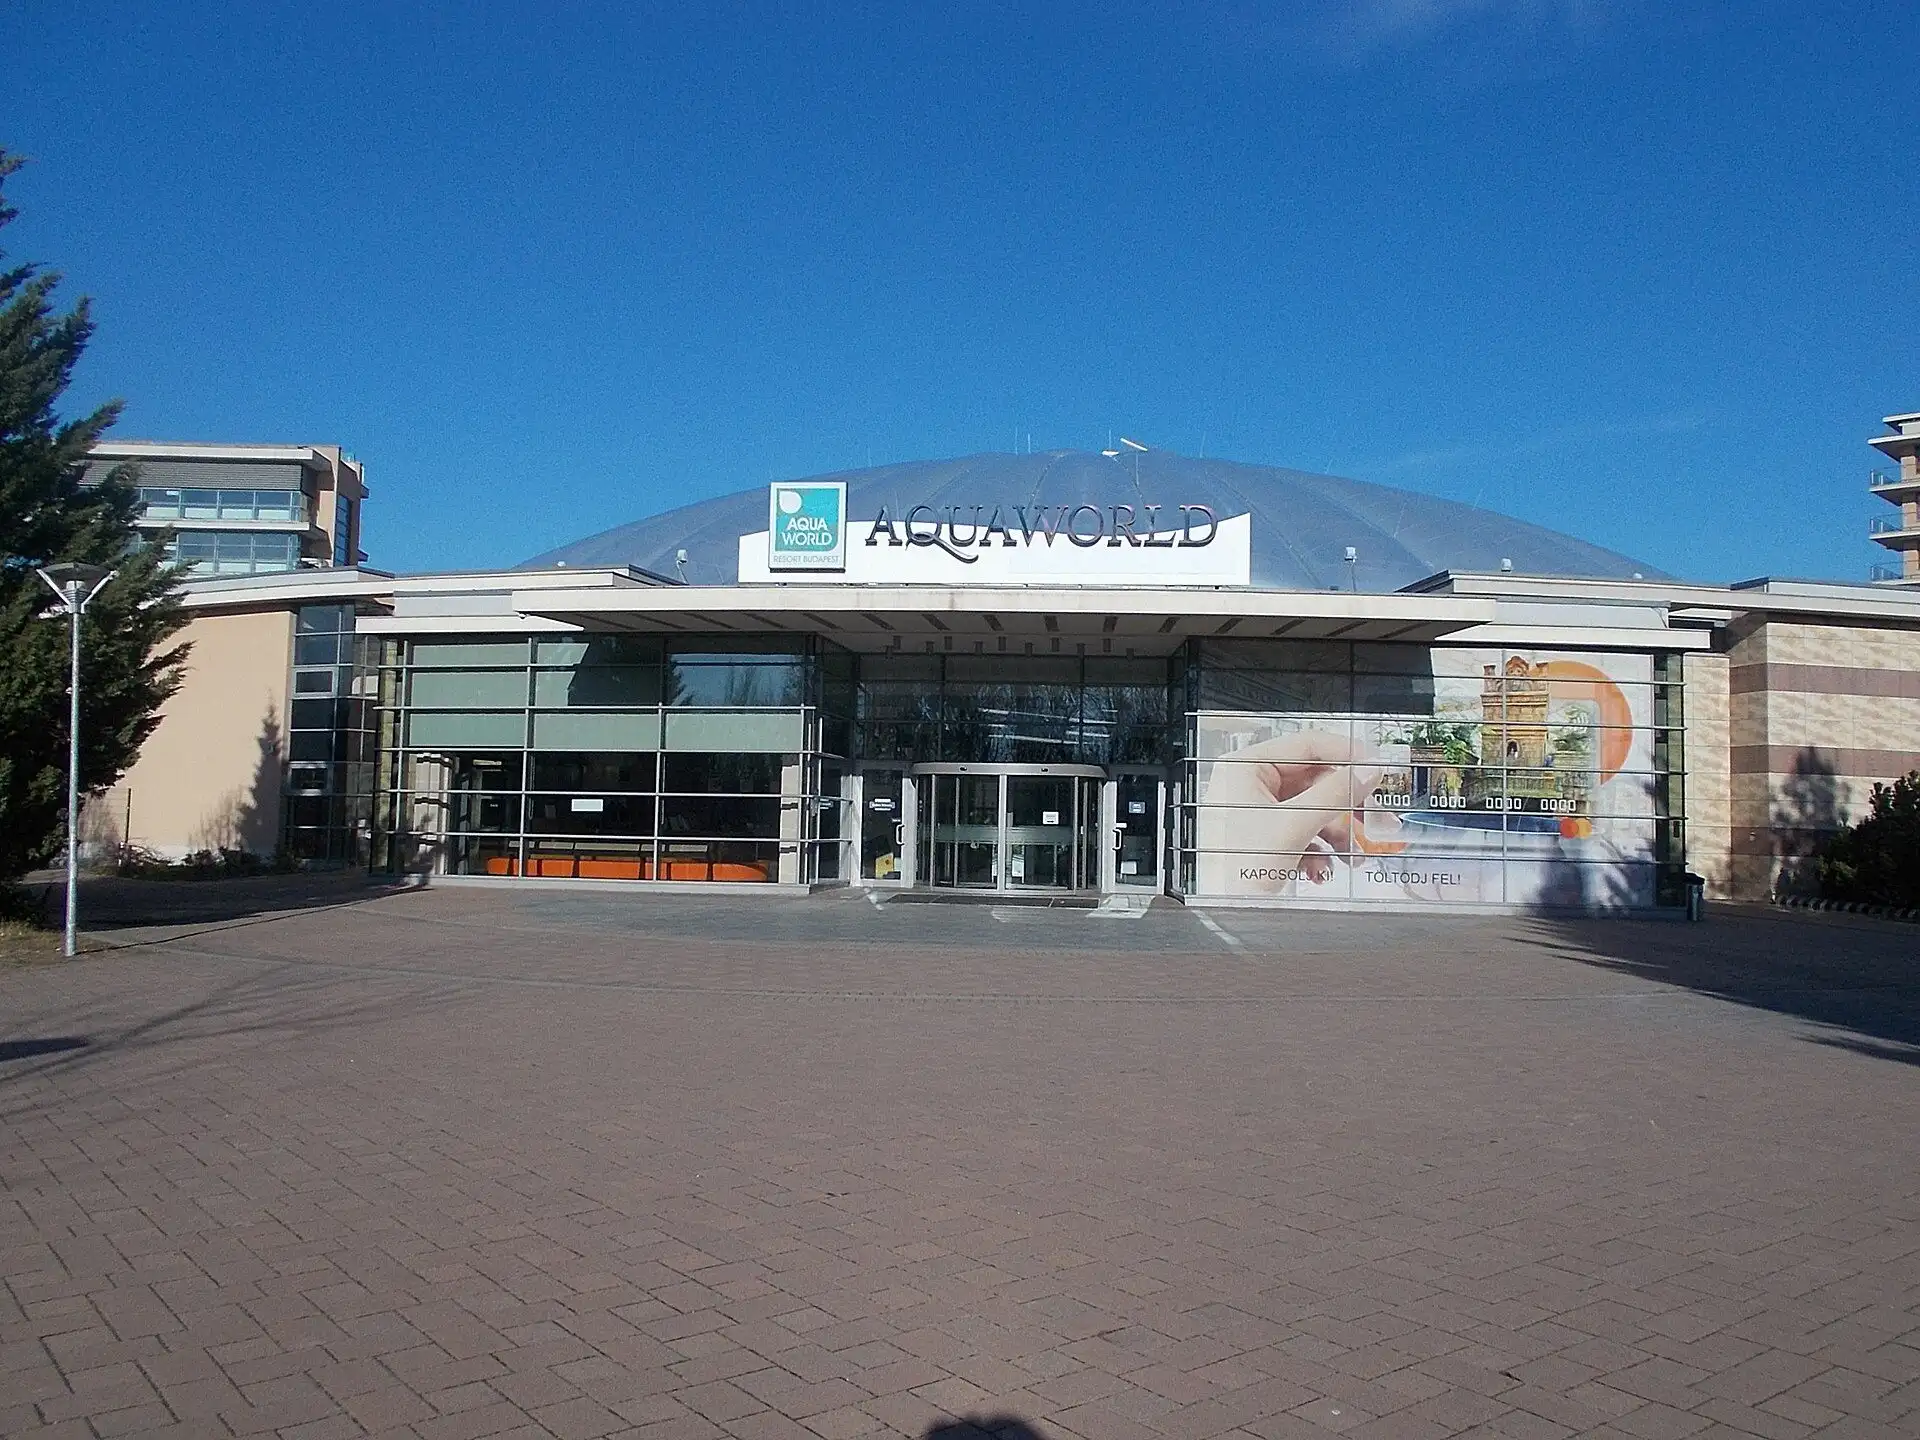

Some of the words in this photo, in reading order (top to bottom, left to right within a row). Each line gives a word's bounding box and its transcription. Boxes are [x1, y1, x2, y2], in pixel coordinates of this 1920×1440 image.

[786, 517, 829, 531] AQUA
[781, 532, 833, 546] WORLD
[865, 503, 1219, 564] AQUAWORLD
[773, 555, 801, 563] RESORT
[803, 555, 839, 563] BUDAPEST
[1240, 868, 1313, 881] KAPCSOLJ
[1431, 873, 1461, 885] FEL!
